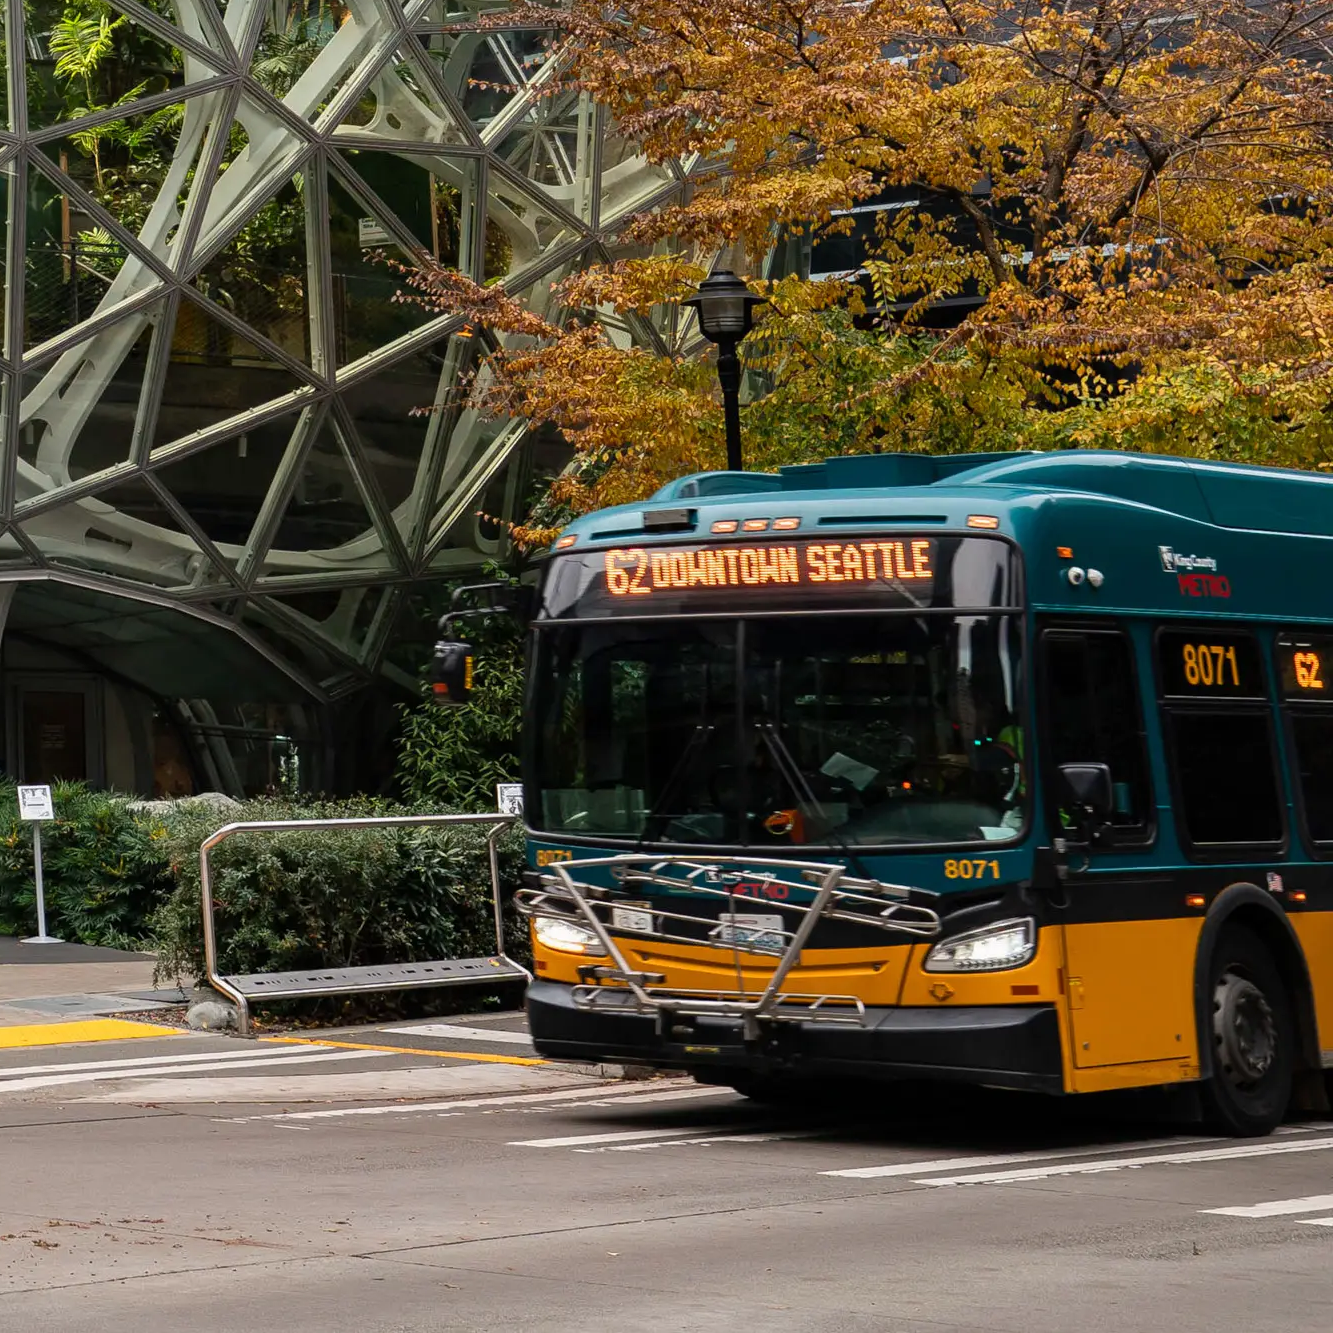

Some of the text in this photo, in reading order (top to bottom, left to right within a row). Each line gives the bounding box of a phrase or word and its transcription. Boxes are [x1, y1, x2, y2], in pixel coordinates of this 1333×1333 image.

[604, 540, 933, 594] 62 DOWNTOWN SEATTLE
[1177, 572, 1231, 598] METRO
[1183, 643, 1240, 686] 8071
[1293, 652, 1324, 688] 62
[944, 858, 1000, 879] 8071
[724, 883, 789, 899] ETRO
